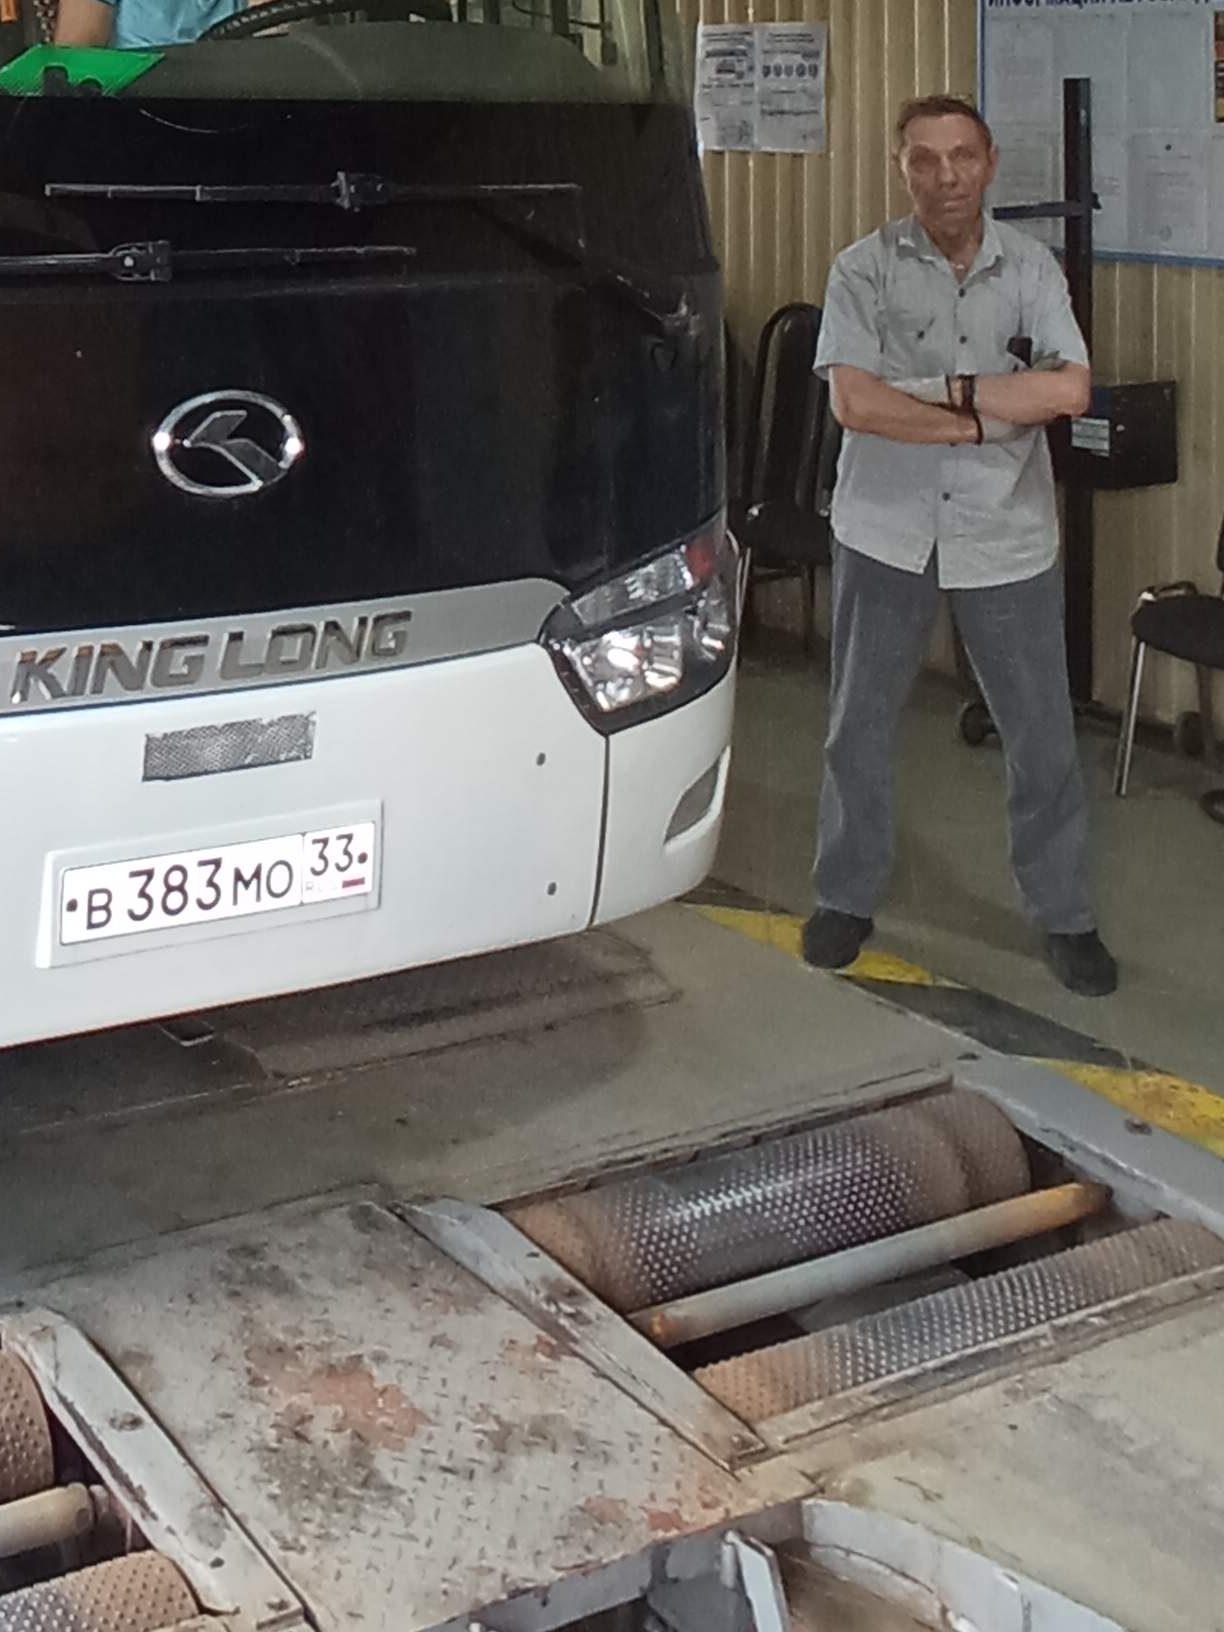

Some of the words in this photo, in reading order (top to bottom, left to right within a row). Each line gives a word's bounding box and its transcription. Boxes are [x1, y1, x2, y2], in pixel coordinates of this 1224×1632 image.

[12, 636, 209, 702] KING
[219, 611, 413, 680] LONG
[310, 833, 355, 877] 33
